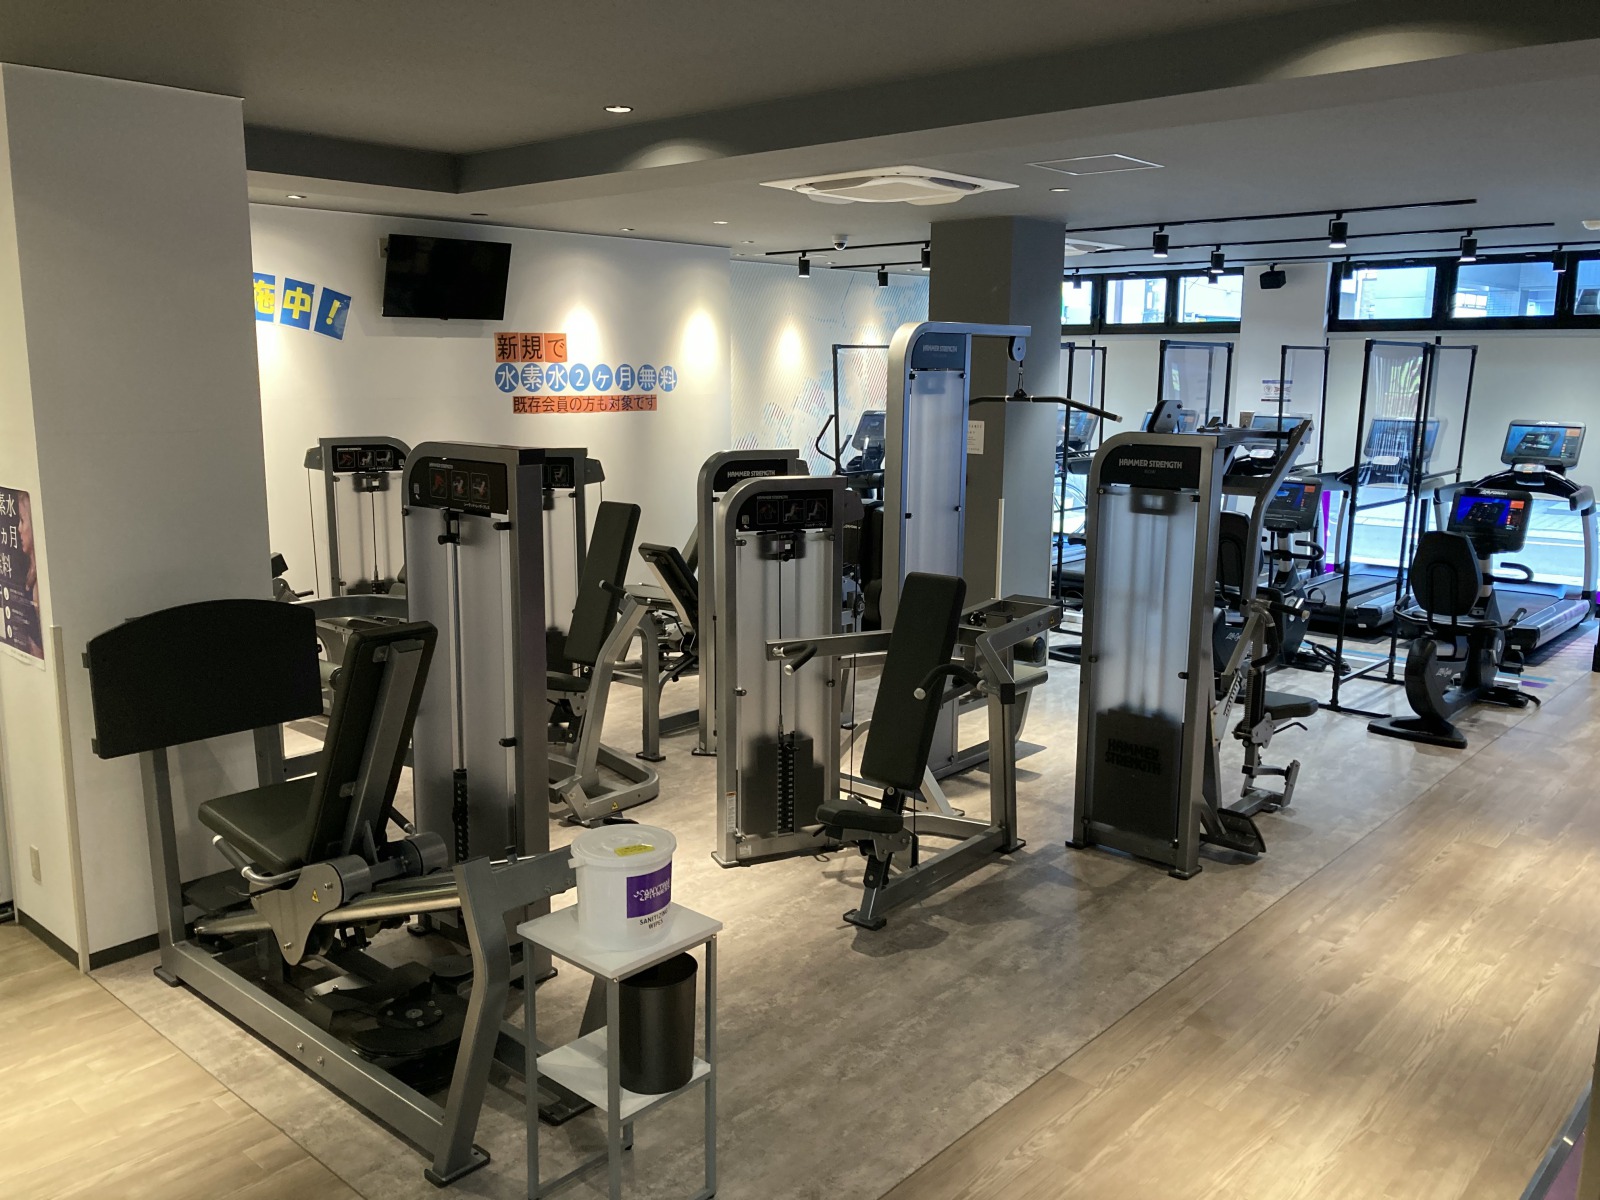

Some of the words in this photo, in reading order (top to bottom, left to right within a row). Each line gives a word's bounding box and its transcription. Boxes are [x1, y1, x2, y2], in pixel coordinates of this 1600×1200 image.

[497, 334, 565, 360] 新規で
[513, 395, 657, 413] 既存会員の方も対象です
[1118, 458, 1148, 467] HAMMER
[1148, 460, 1183, 469] STRENGTH
[727, 470, 750, 478] HAMMER
